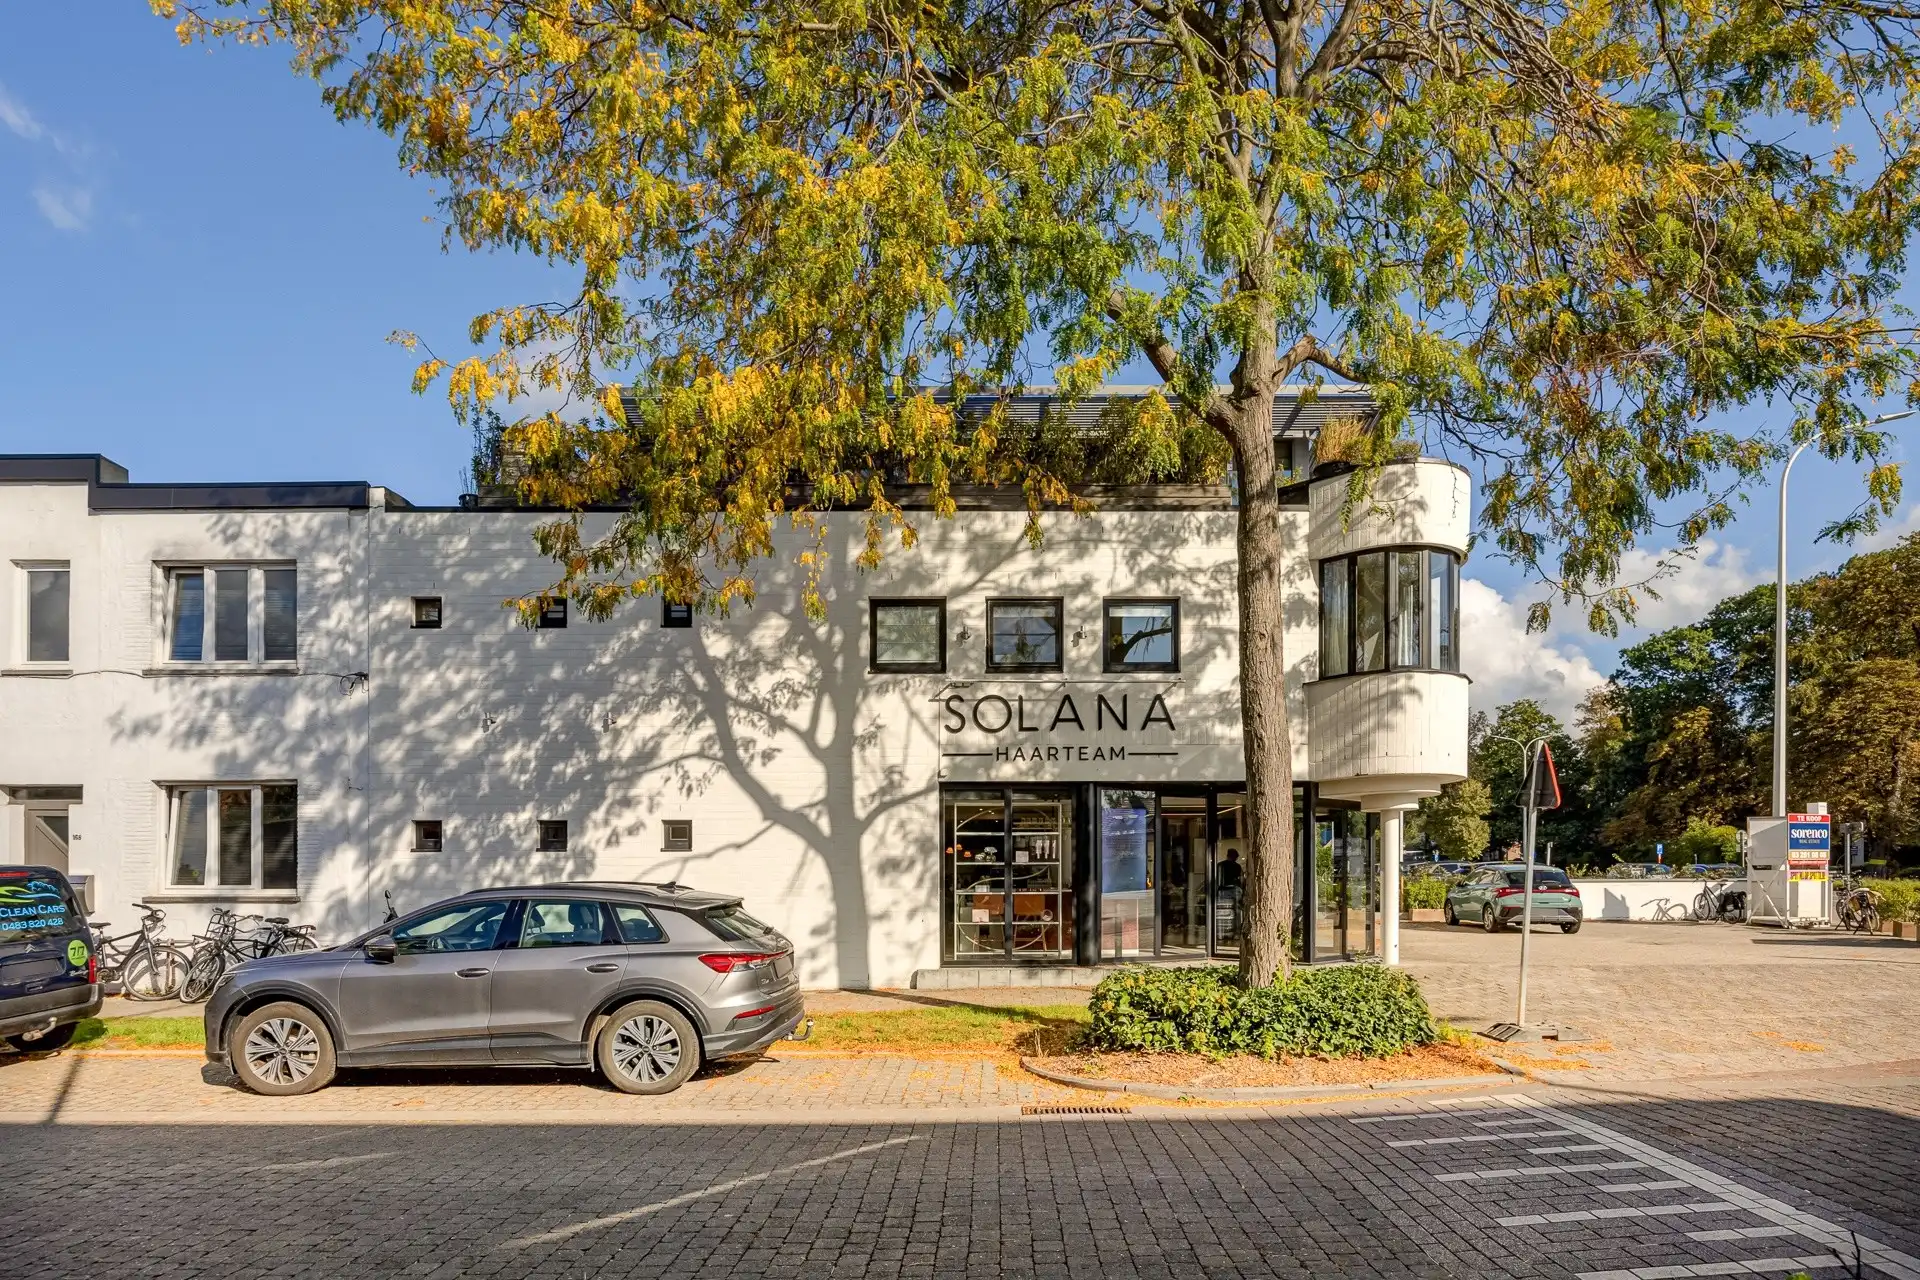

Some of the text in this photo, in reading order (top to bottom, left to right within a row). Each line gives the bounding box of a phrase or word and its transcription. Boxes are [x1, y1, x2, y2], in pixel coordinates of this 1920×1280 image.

[944, 693, 1176, 734] SOLANA
[995, 746, 1126, 762] HAARTEAM
[1790, 828, 1828, 839] sorenco
[0, 904, 65, 917] CLEAN CARS
[2, 917, 64, 931] 0483 820 428
